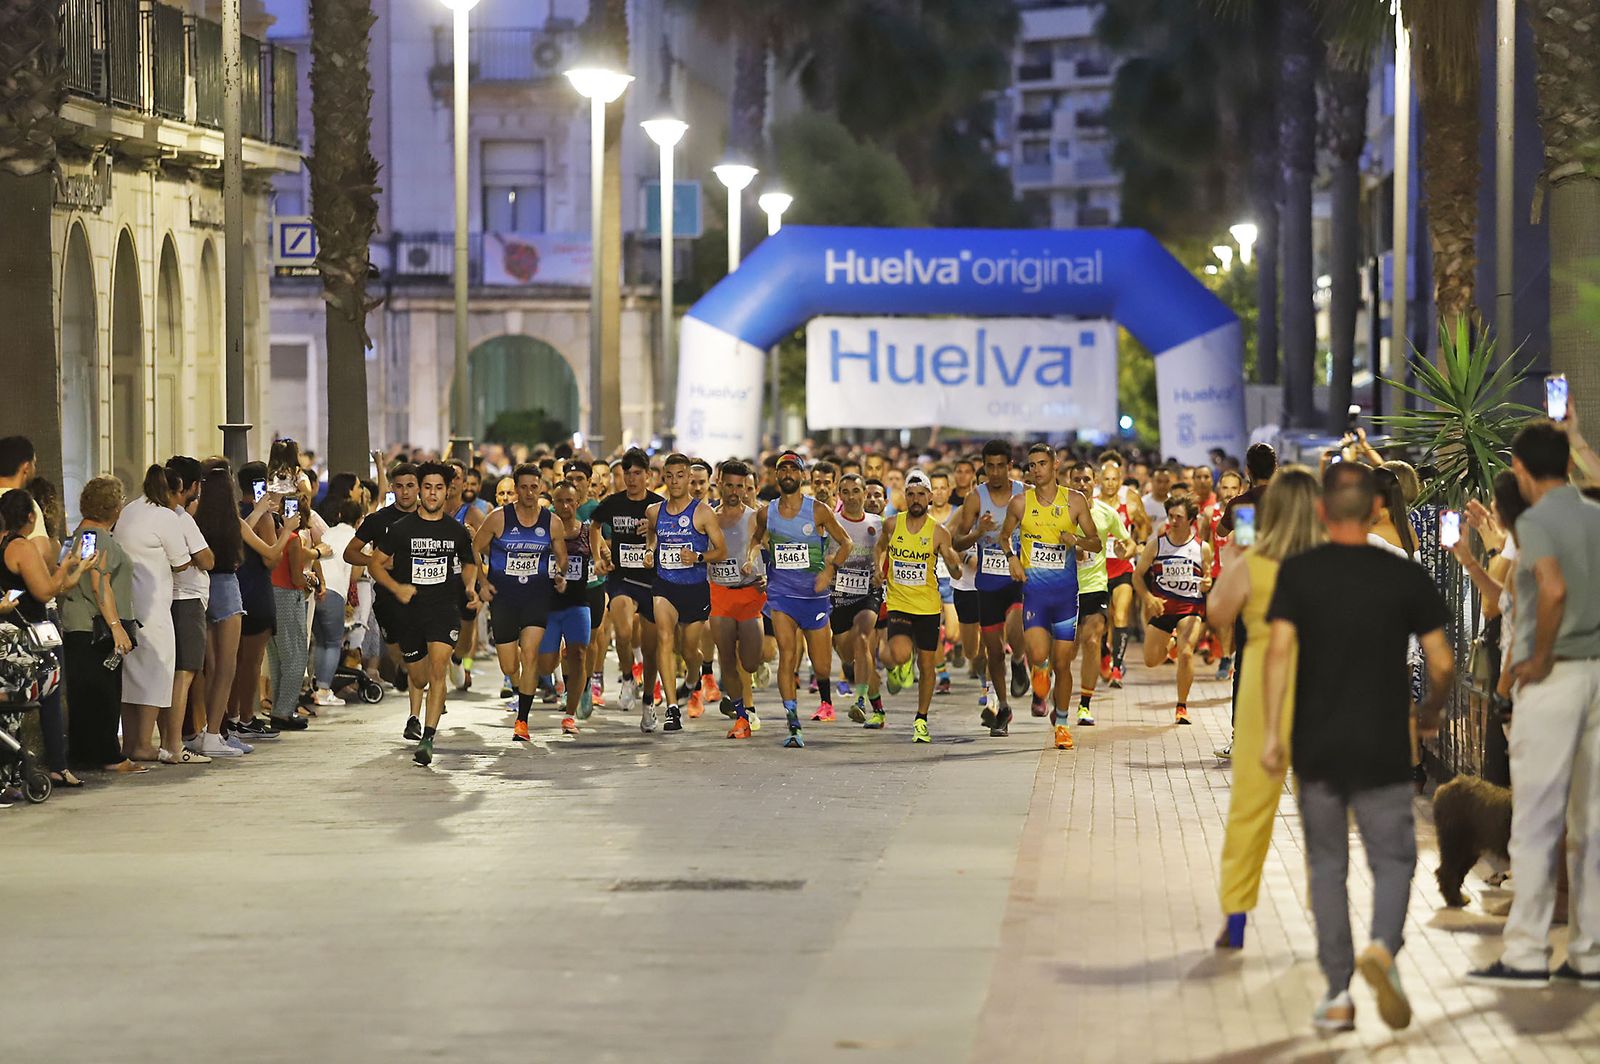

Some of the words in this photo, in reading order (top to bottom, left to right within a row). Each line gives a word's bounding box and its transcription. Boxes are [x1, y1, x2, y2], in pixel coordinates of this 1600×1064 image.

[825, 249, 959, 285] Huelva
[971, 249, 1103, 293] original
[829, 328, 1073, 387] Huelva
[412, 540, 427, 549] RUN
[428, 540, 442, 549] FOR
[442, 540, 455, 549] FUN
[628, 552, 644, 562] 604
[783, 553, 800, 562] 646
[1039, 551, 1057, 562] 249
[515, 560, 531, 570] 548
[990, 557, 1006, 568] 751
[422, 567, 438, 577] 198
[716, 567, 730, 577] 579
[900, 570, 917, 580] 655
[1170, 566, 1185, 576] 303
[845, 577, 860, 588] 111
